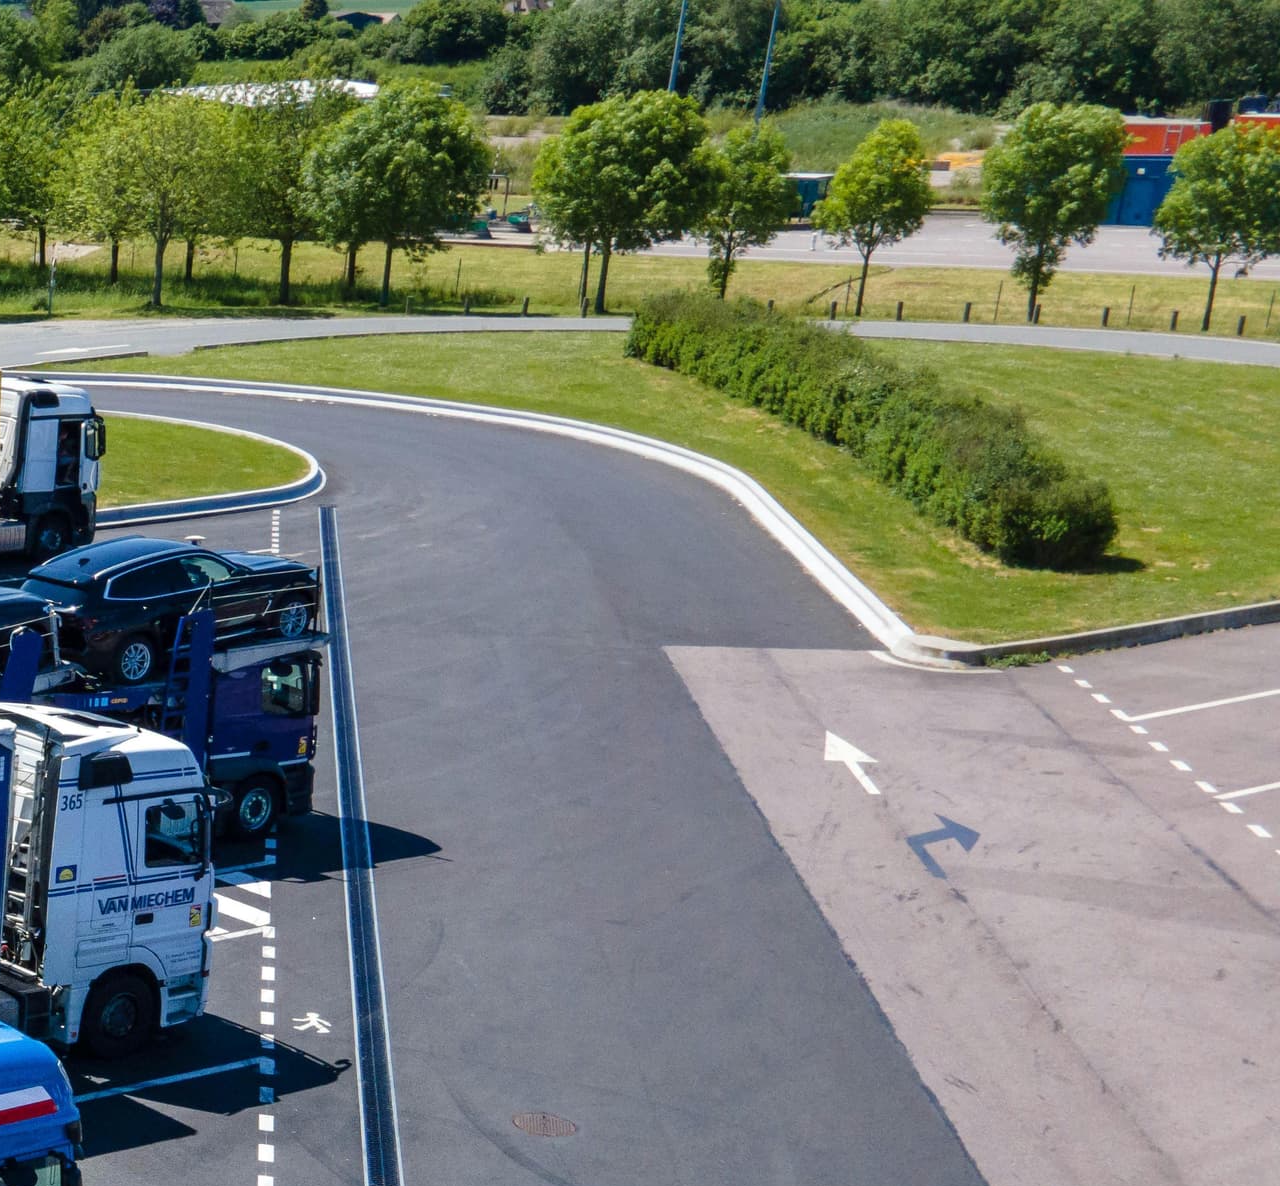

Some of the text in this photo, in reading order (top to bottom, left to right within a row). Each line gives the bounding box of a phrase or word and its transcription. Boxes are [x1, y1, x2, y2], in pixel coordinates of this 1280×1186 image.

[60, 793, 83, 811] 365
[98, 886, 196, 915] VAN MIEGHEM
